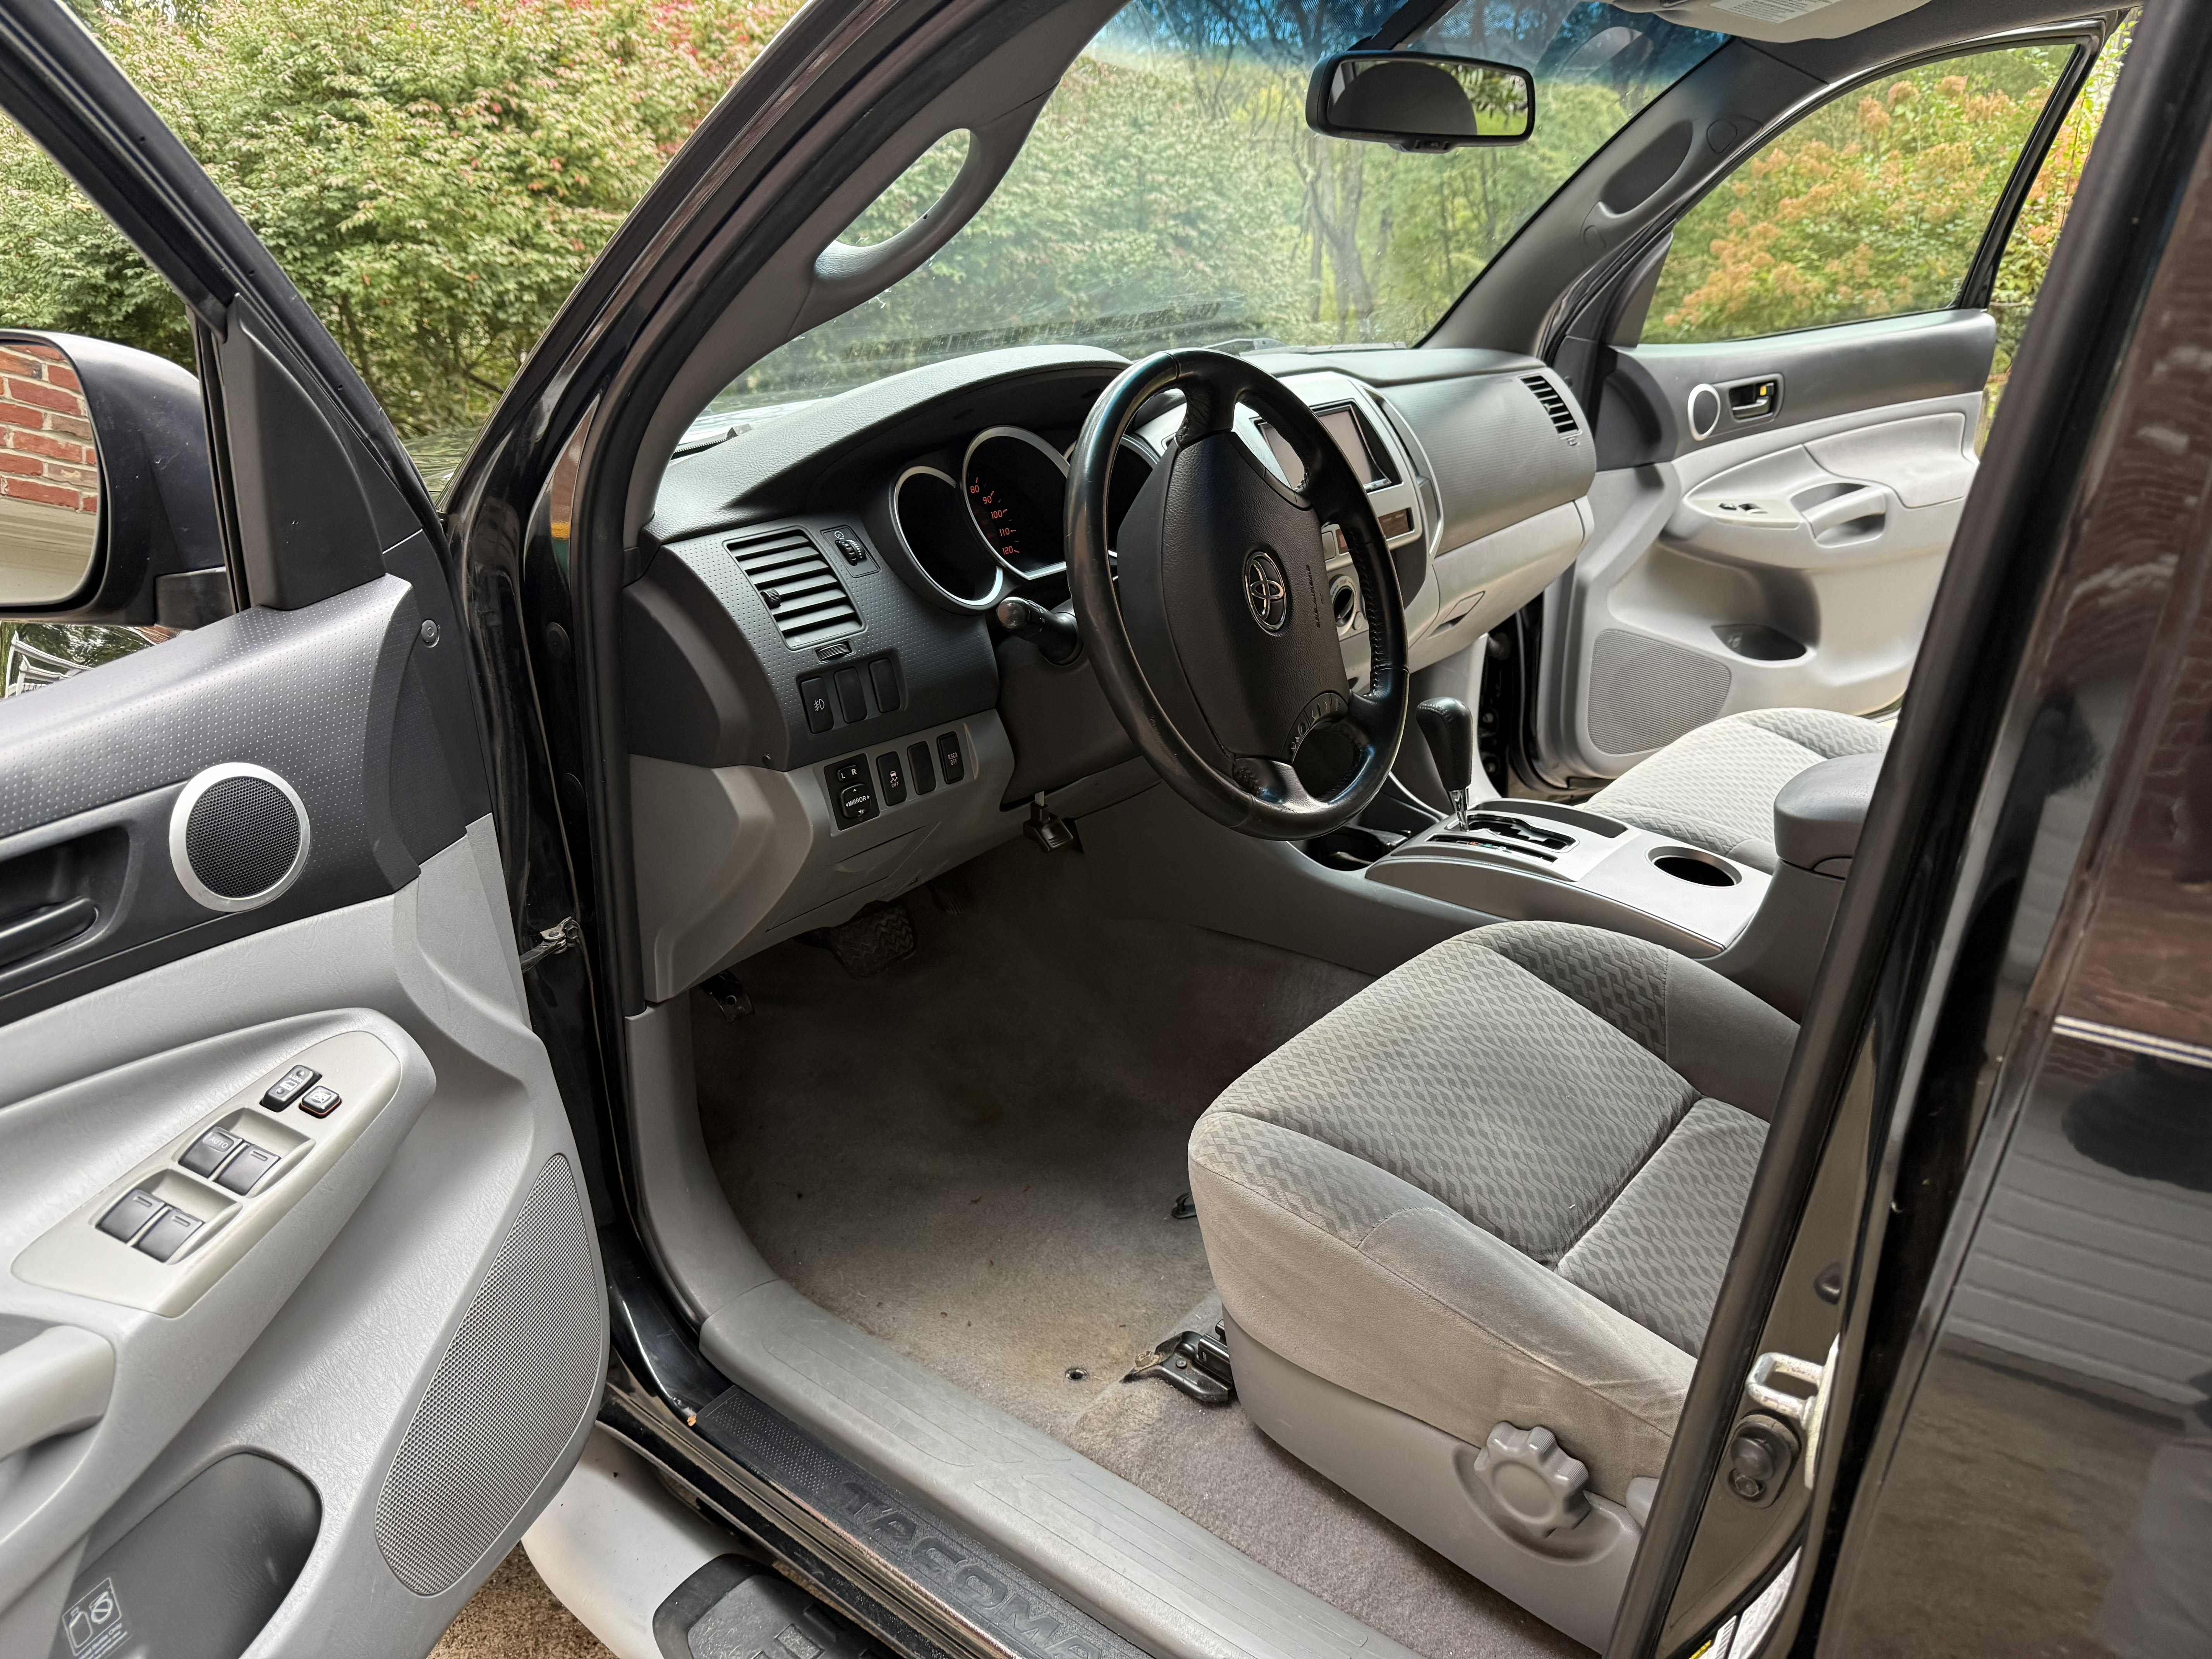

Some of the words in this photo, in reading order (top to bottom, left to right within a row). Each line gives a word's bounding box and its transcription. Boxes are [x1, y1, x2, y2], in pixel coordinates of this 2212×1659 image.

[970, 485, 979, 493] 80
[982, 496, 992, 504] 90
[991, 510, 1003, 519] 100
[999, 527, 1010, 536] 110
[1002, 546, 1013, 555] 120
[848, 795, 867, 807] MIRROR
[209, 1137, 228, 1149] AUTO
[841, 1481, 1101, 1659] TACOMA
